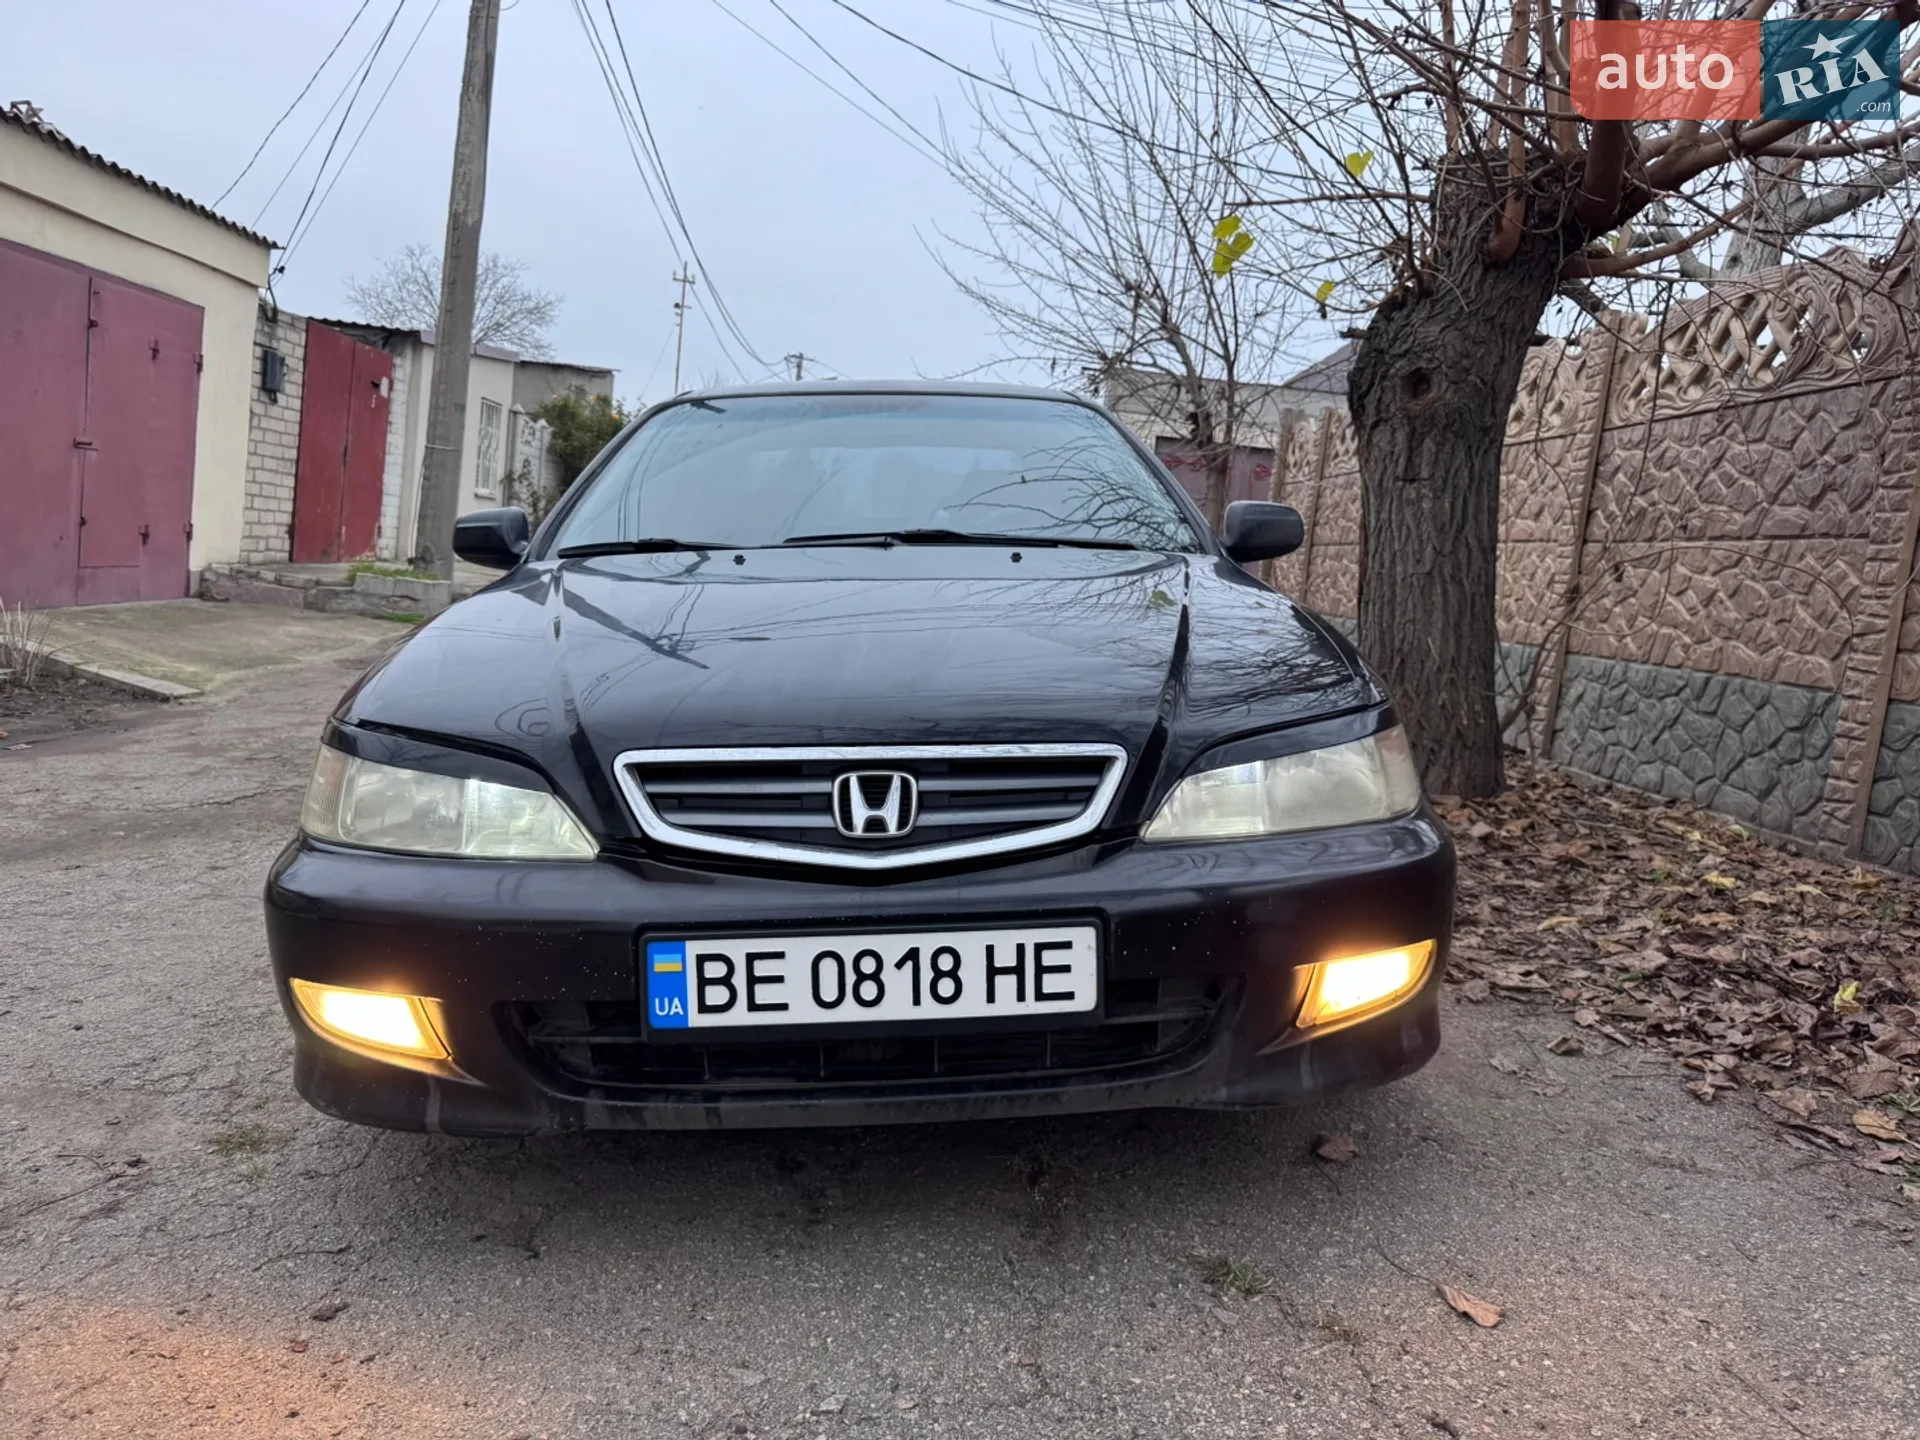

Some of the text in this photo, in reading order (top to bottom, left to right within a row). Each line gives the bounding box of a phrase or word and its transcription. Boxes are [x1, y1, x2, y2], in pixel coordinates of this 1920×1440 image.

[695, 940, 1075, 1014] BE 0818 HE
[654, 997, 684, 1016] UA
